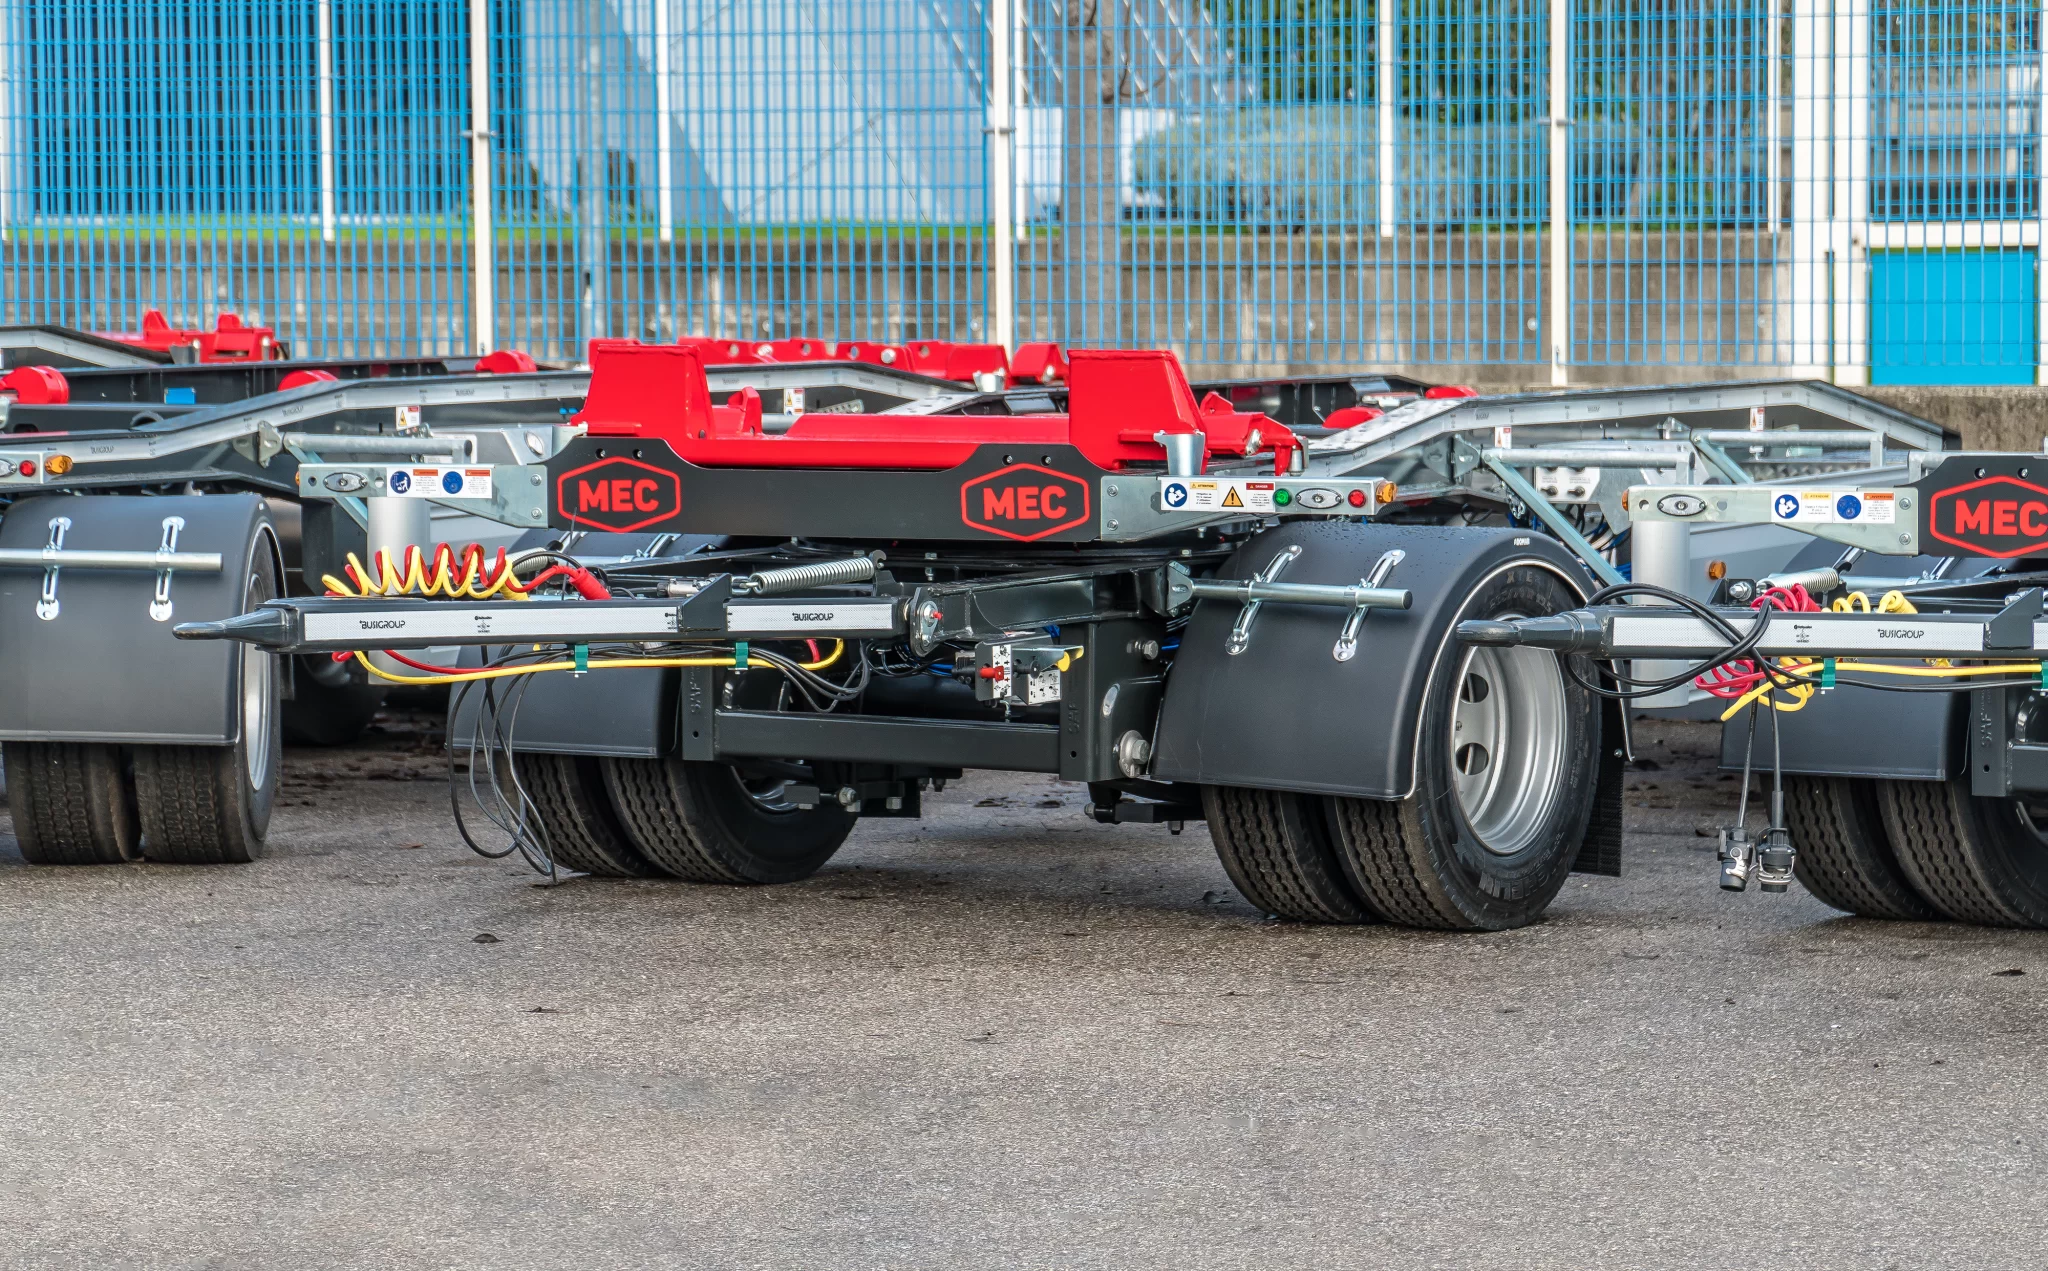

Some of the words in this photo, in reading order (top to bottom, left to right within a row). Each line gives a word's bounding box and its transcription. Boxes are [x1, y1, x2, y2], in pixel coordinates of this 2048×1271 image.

[579, 479, 659, 512] MEC
[983, 485, 1067, 520] MEC
[1955, 499, 2048, 537] MEC
[360, 620, 406, 629] BUSIGROUP
[792, 612, 834, 622] BUSIGROUP
[1877, 628, 1925, 639] BUSIGROUP
